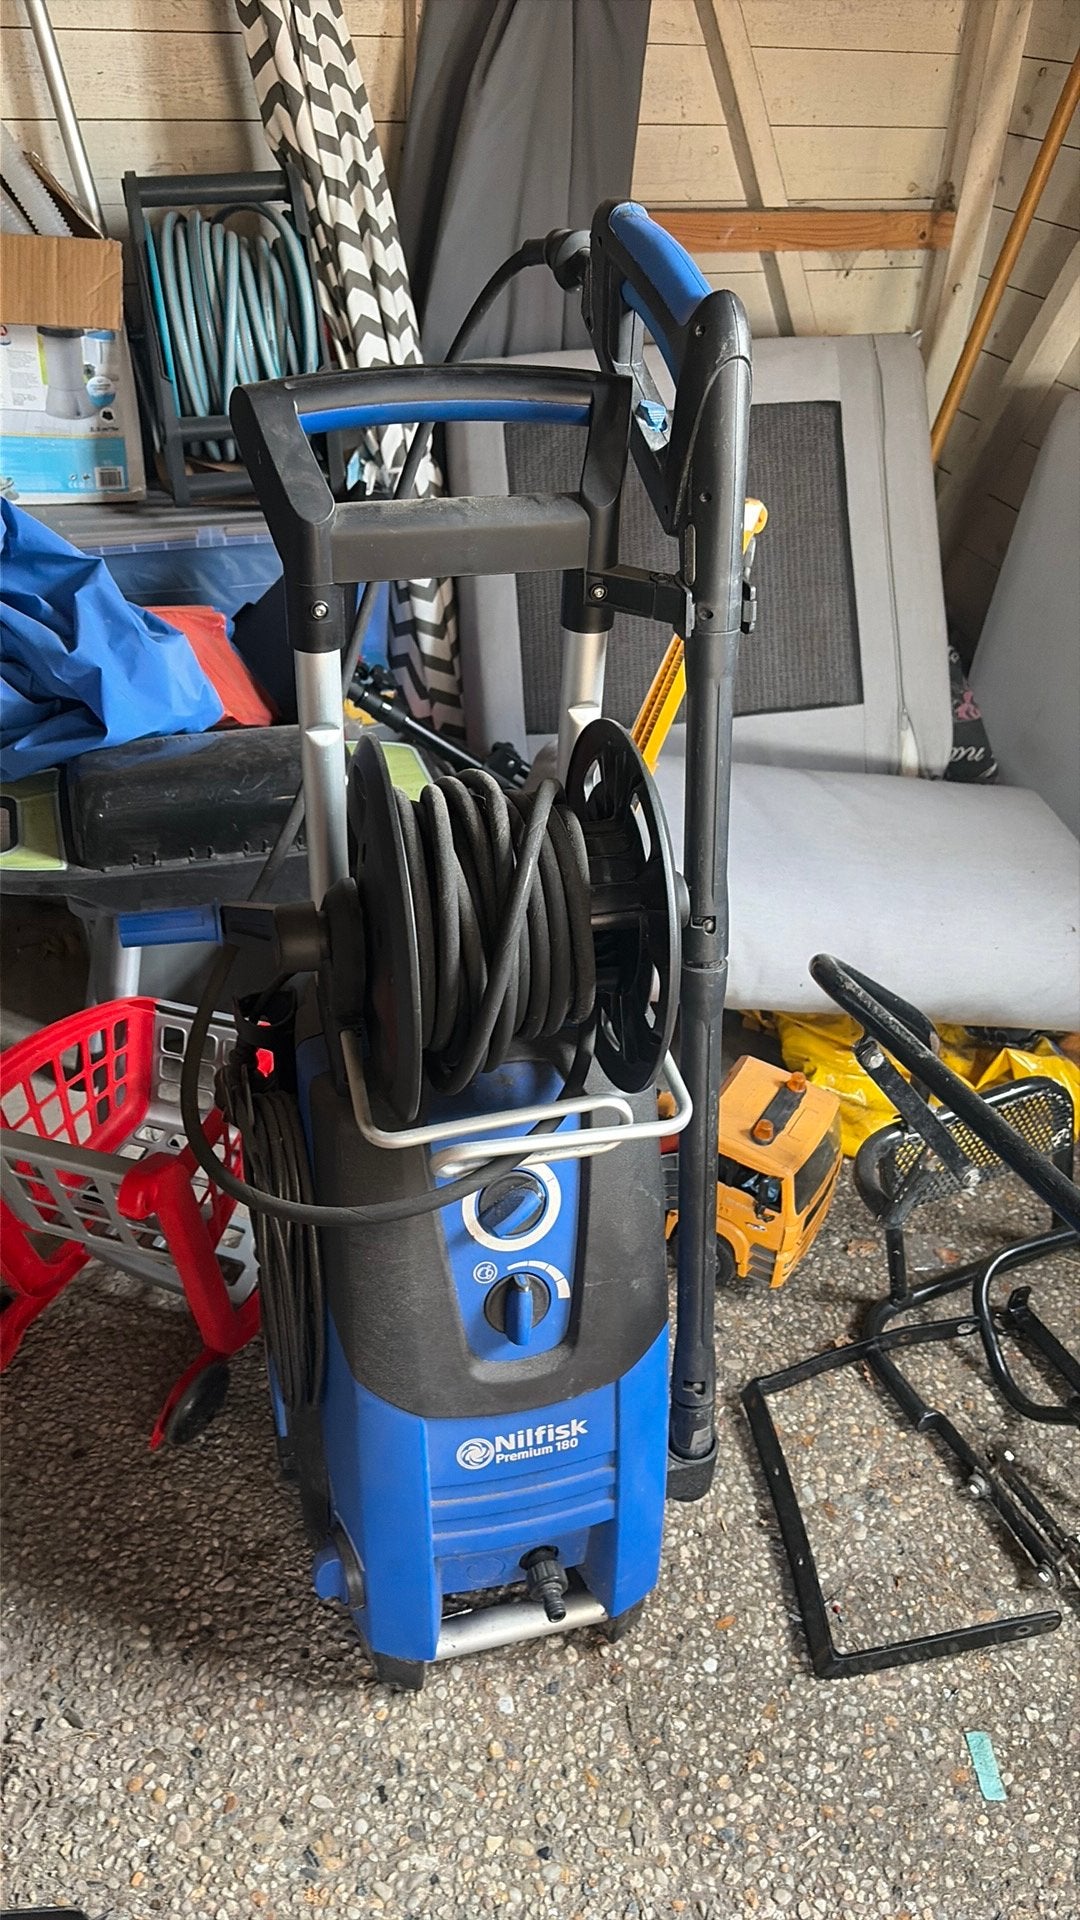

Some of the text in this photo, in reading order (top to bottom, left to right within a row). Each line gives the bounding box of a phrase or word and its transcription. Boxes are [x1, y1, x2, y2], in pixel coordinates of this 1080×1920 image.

[495, 1419, 588, 1453] Nilfisk
[495, 1438, 579, 1464] Premium 180
